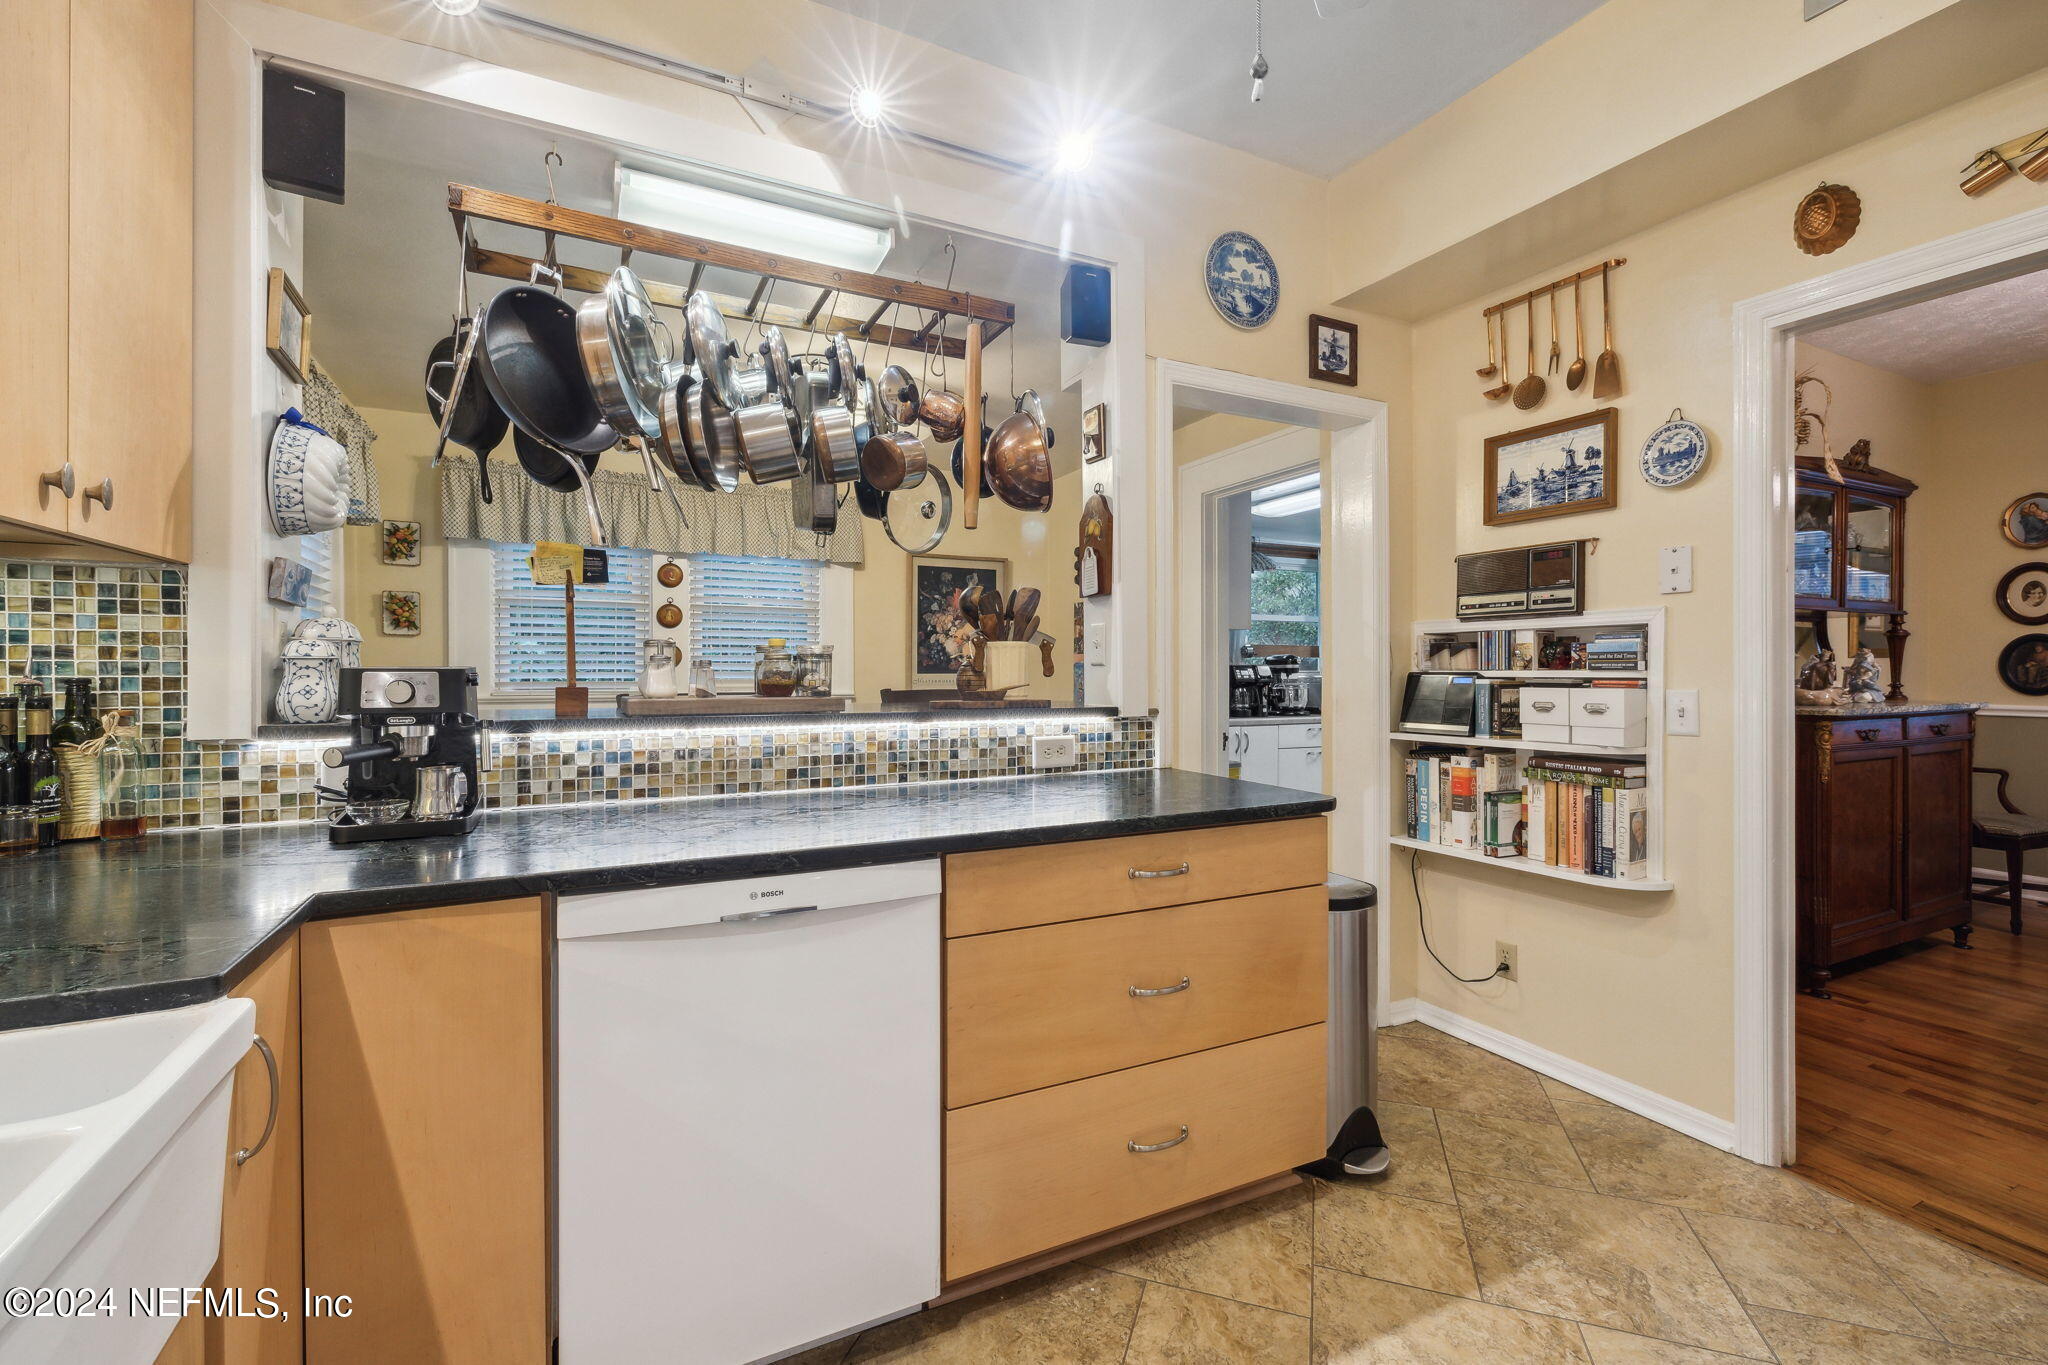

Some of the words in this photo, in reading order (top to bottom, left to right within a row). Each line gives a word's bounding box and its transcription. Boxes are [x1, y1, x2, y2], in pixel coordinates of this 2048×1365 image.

[1564, 763, 1586, 771] ITALIAN
[1588, 777, 1609, 785] ROME
[1420, 787, 1428, 823] PEPIN
[761, 890, 784, 898] BOSCH
